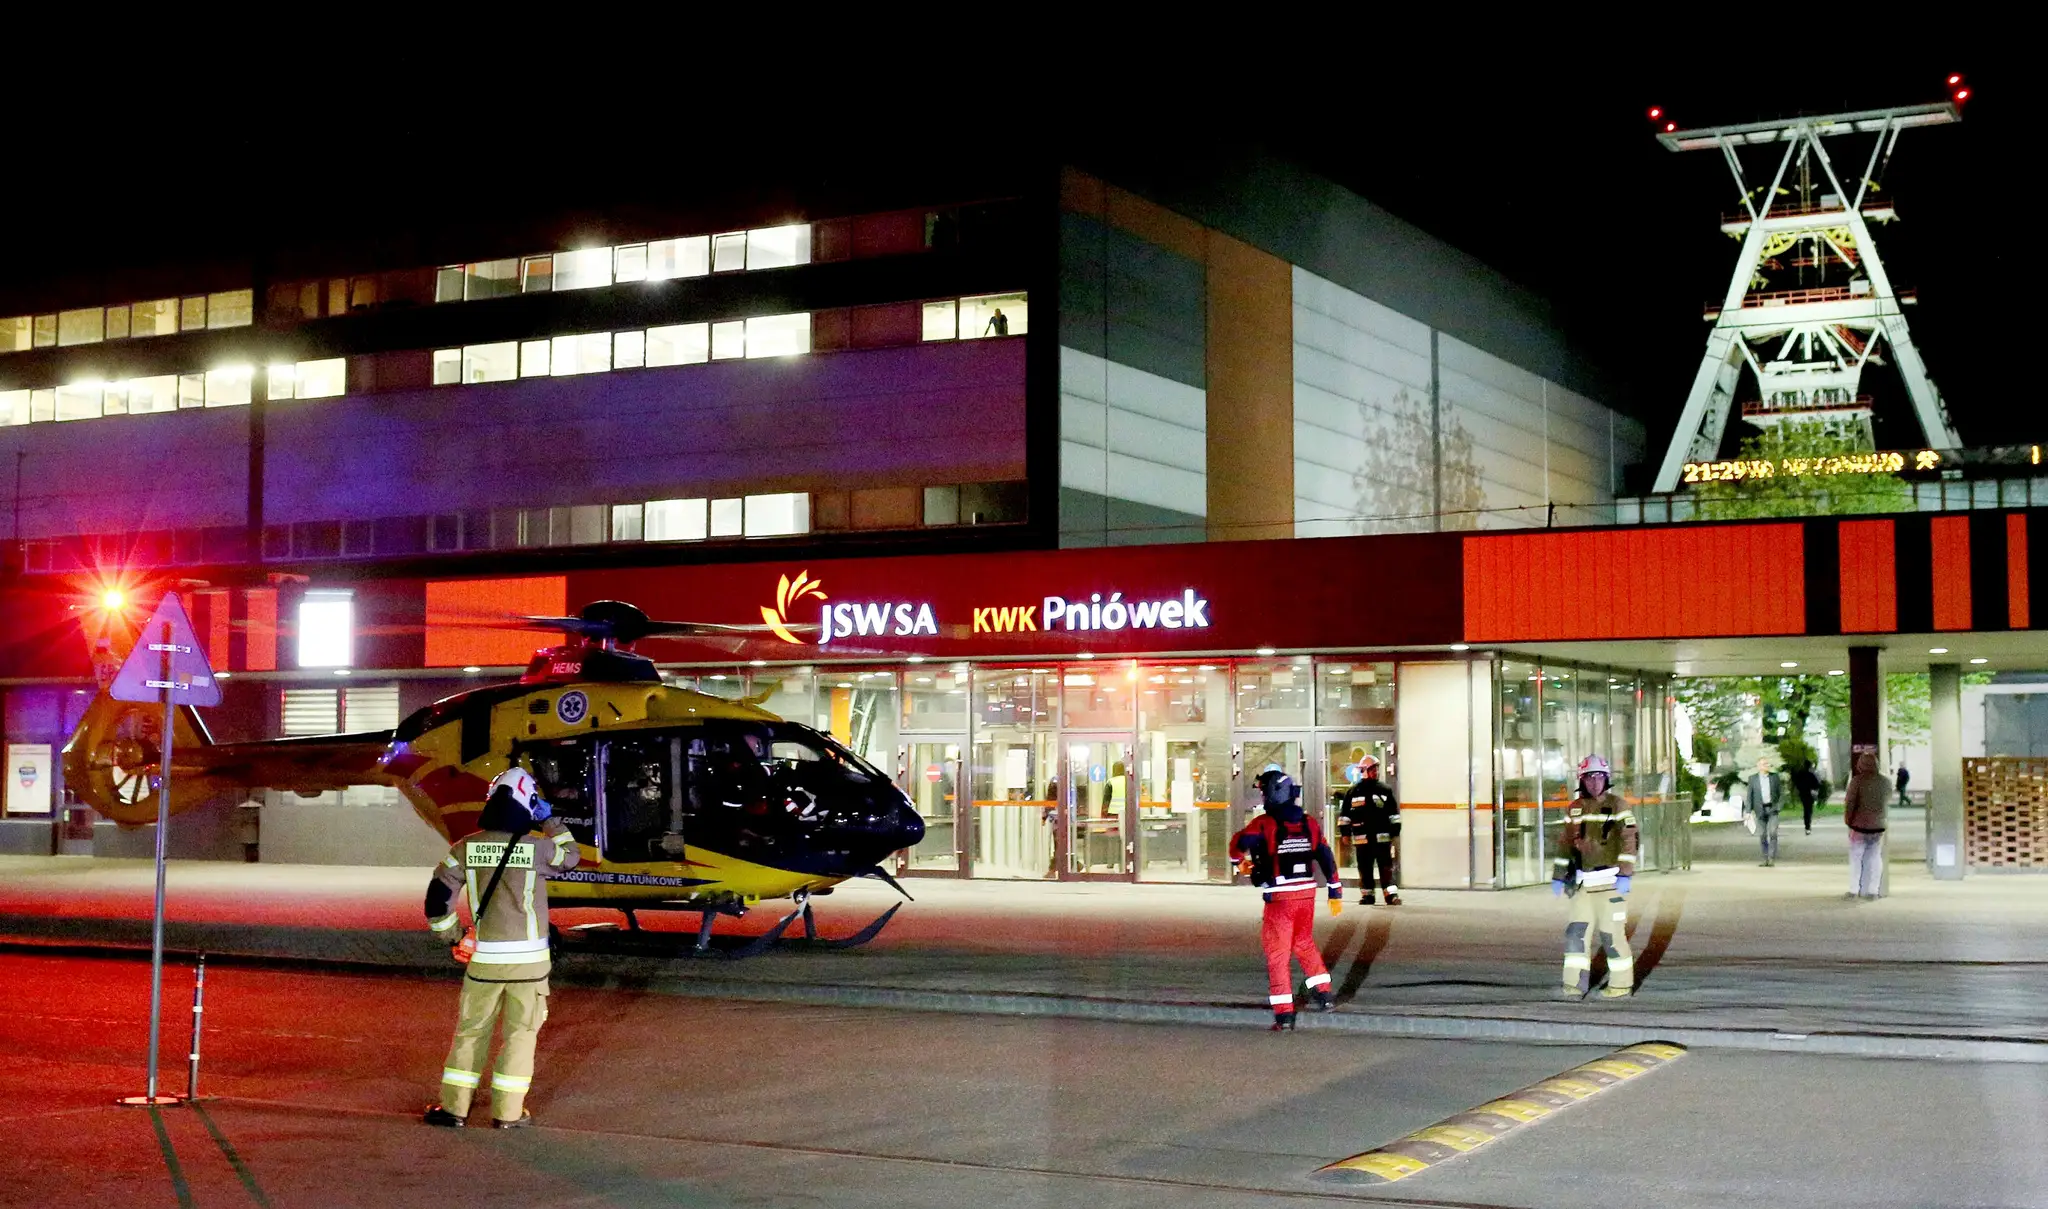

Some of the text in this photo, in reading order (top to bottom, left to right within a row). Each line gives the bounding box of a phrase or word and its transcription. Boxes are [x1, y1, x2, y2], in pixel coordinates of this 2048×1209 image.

[973, 588, 1209, 633] KWK Pniówek
[818, 602, 938, 645] JSW SA
[552, 663, 581, 674] HEMS
[495, 855, 531, 865] PARNA
[618, 874, 683, 887] RATUNKOWE
